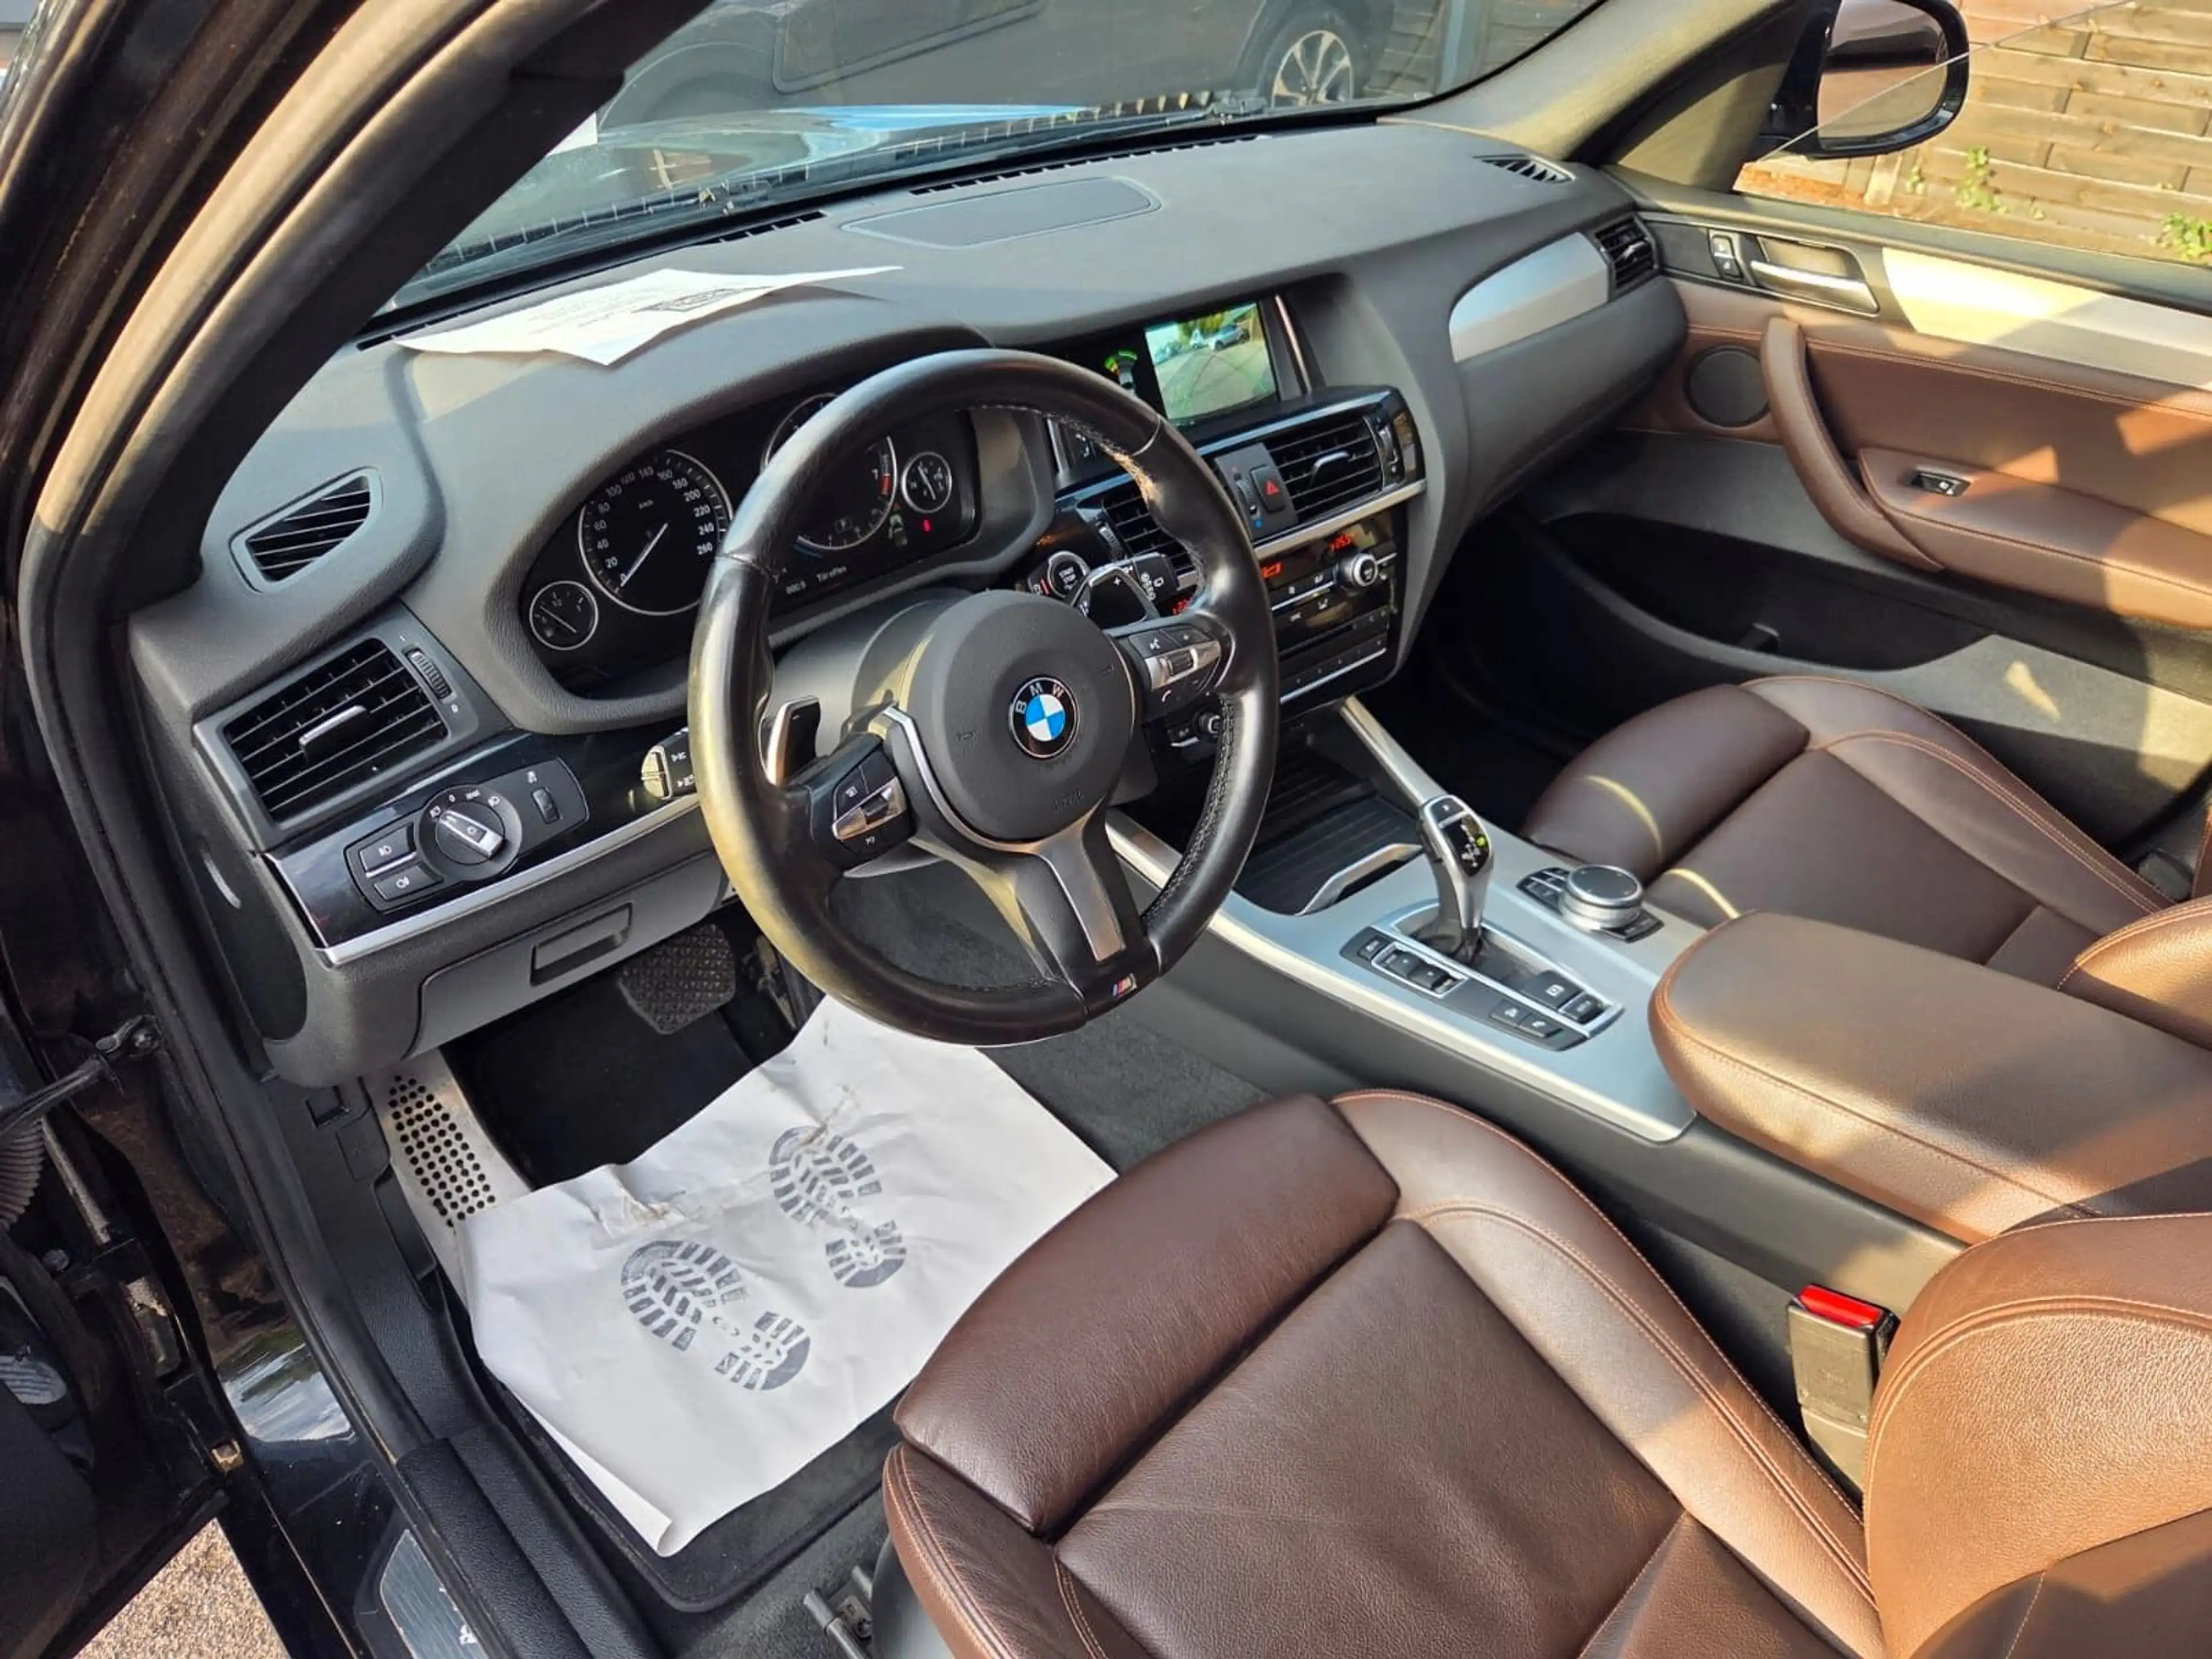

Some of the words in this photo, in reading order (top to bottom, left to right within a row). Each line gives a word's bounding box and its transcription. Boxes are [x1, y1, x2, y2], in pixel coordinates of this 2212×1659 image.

[672, 478, 688, 490] 180
[606, 484, 622, 498] 100
[683, 489, 701, 502] 200
[598, 502, 611, 514] 80
[694, 505, 710, 517] 220
[594, 520, 607, 531] 60
[698, 522, 714, 536] 240
[597, 539, 609, 550] 40
[606, 556, 618, 568] 20
[1015, 682, 1065, 714] BMW
